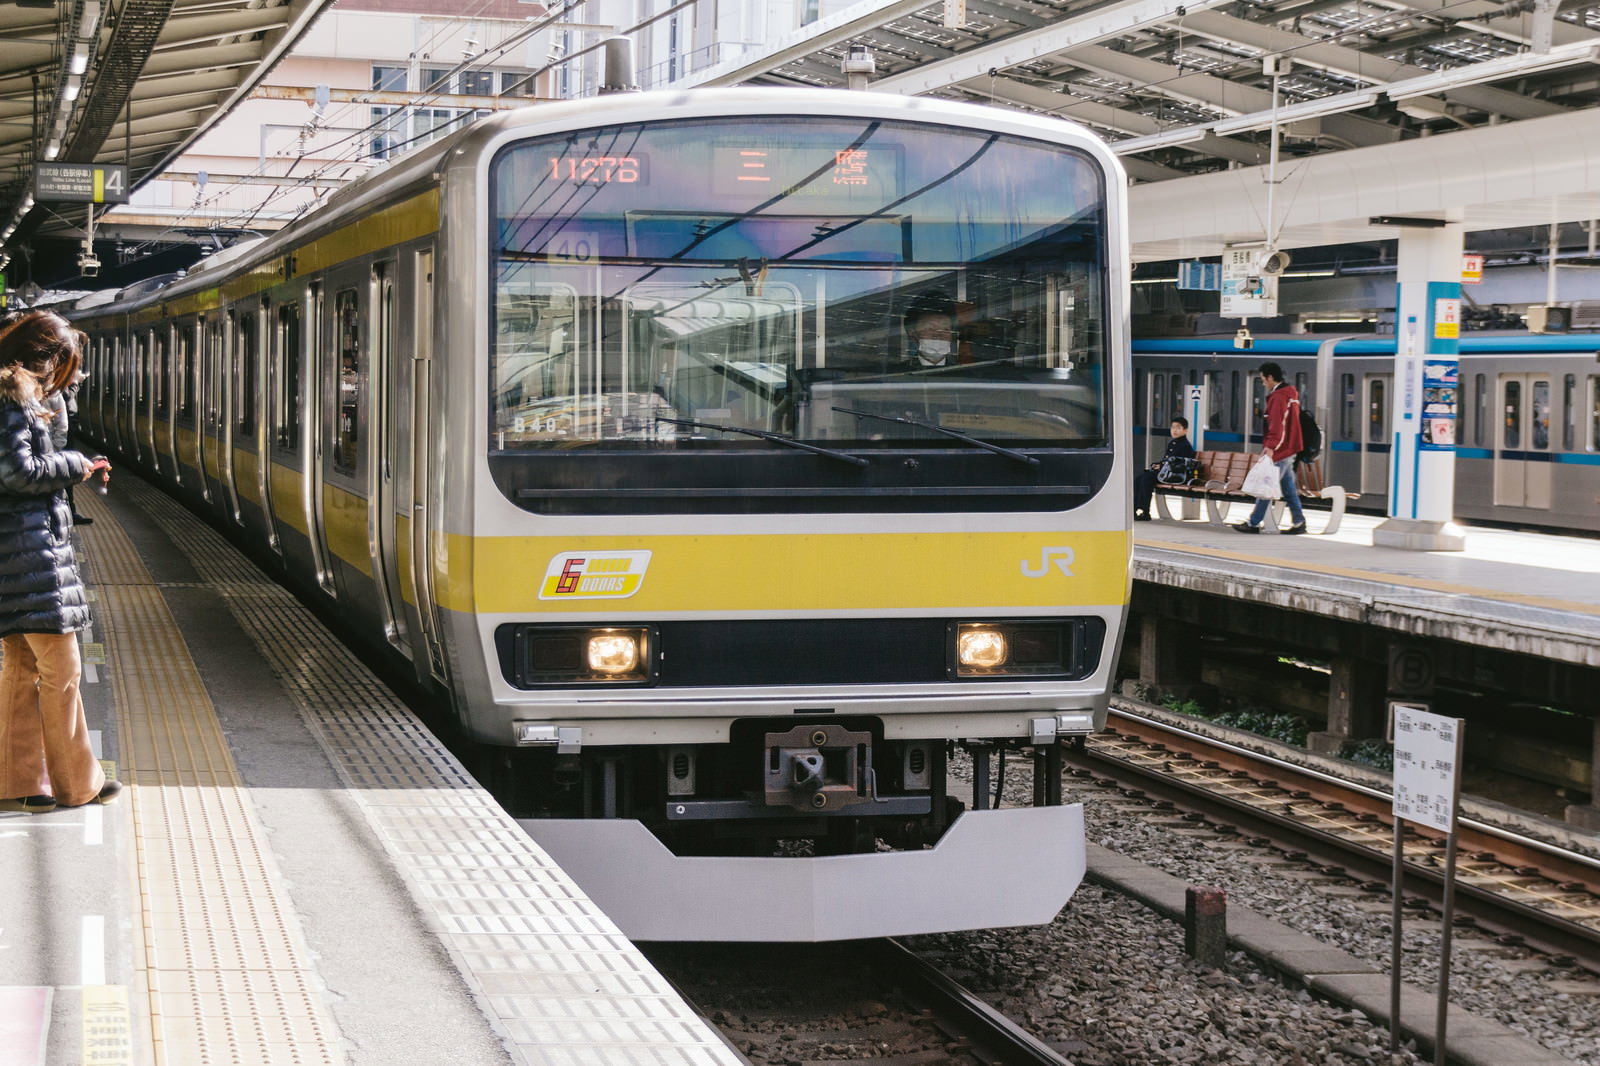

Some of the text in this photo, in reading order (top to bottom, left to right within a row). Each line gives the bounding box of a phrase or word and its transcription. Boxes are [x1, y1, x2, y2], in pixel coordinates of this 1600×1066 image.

[105, 170, 124, 196] 4
[556, 240, 591, 261] 40
[555, 558, 626, 593] 6 DOORS
[1020, 546, 1075, 578] JR
